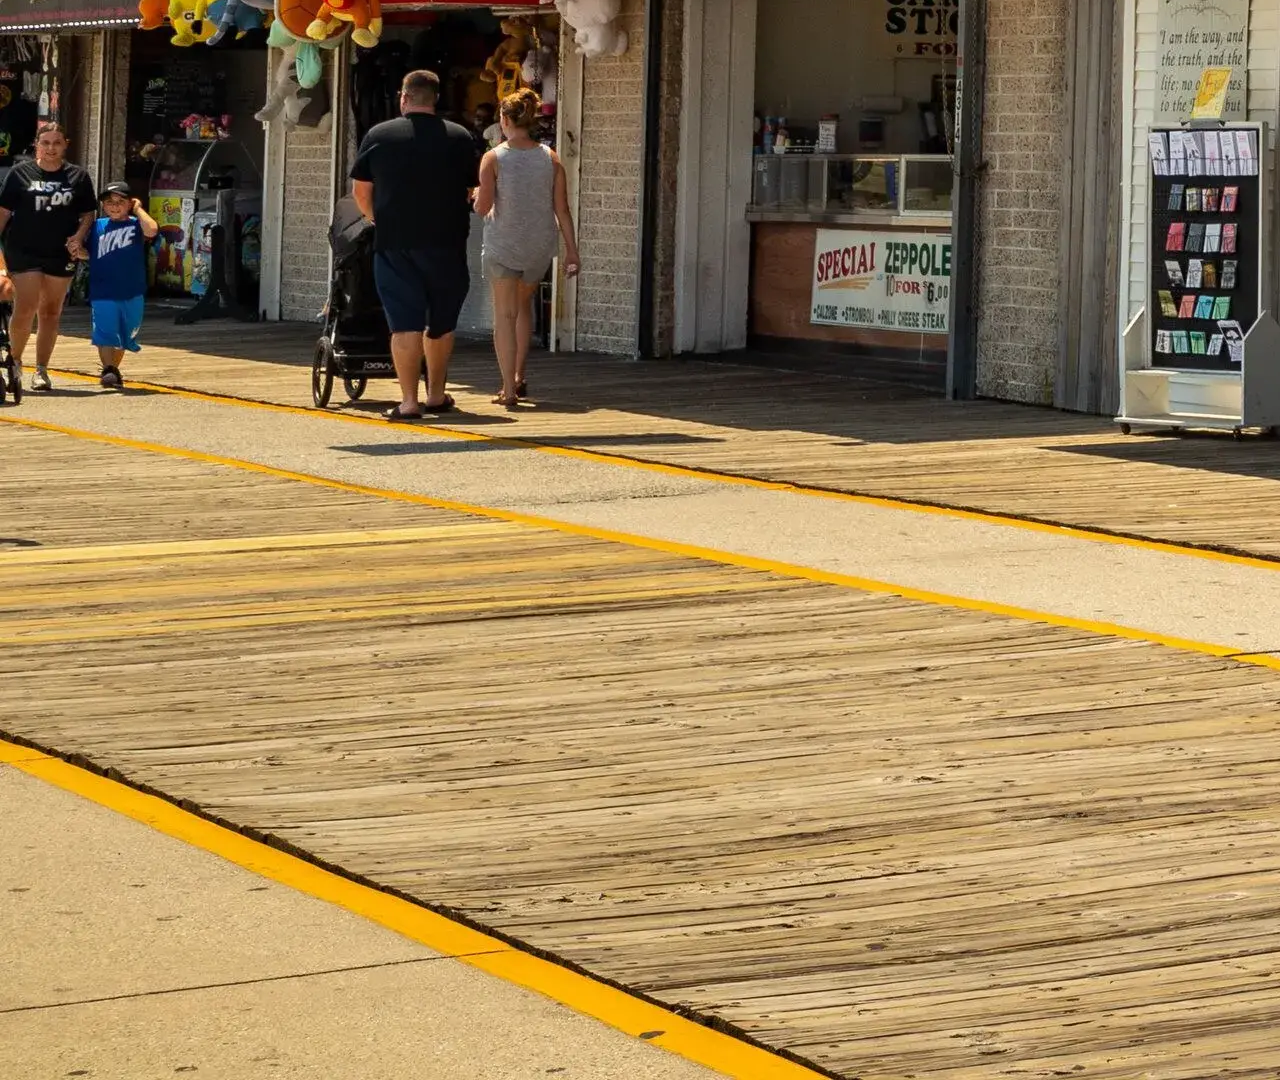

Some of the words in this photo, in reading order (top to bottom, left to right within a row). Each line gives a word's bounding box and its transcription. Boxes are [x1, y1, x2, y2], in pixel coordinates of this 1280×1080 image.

[1169, 33, 1182, 44] am
[1184, 27, 1199, 44] the
[1226, 26, 1246, 43] and
[1161, 51, 1179, 67] the
[1207, 48, 1226, 65] and
[1227, 48, 1243, 66] the
[1182, 80, 1193, 91] no
[1160, 99, 1170, 112] to
[1172, 98, 1187, 112] the
[97, 226, 137, 258] NIKE
[885, 242, 952, 276] ZEPPOLE
[895, 281, 921, 294] FOR
[922, 313, 945, 329] STEAK
